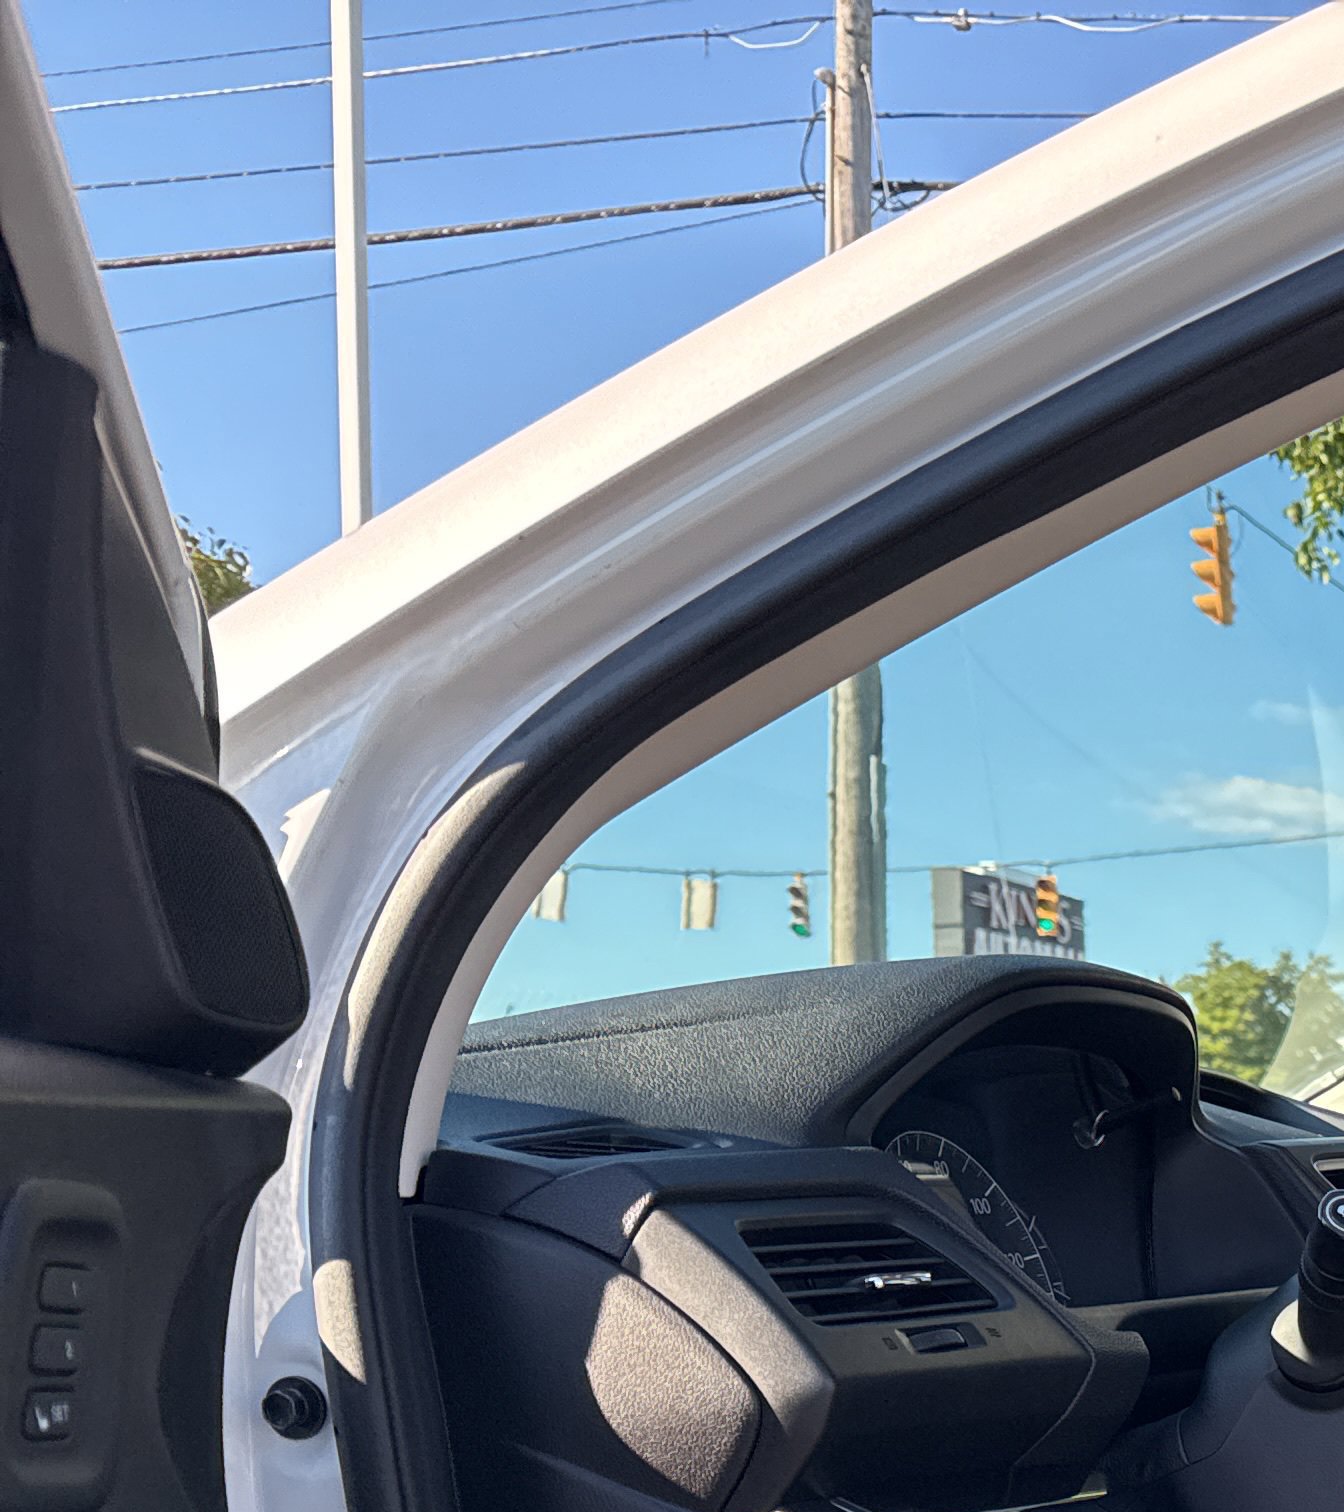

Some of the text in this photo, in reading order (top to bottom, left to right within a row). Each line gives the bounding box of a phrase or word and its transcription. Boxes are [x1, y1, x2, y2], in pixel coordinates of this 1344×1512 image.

[988, 881, 1071, 944] KINS
[934, 1160, 949, 1177] 80
[970, 1198, 991, 1215] 100
